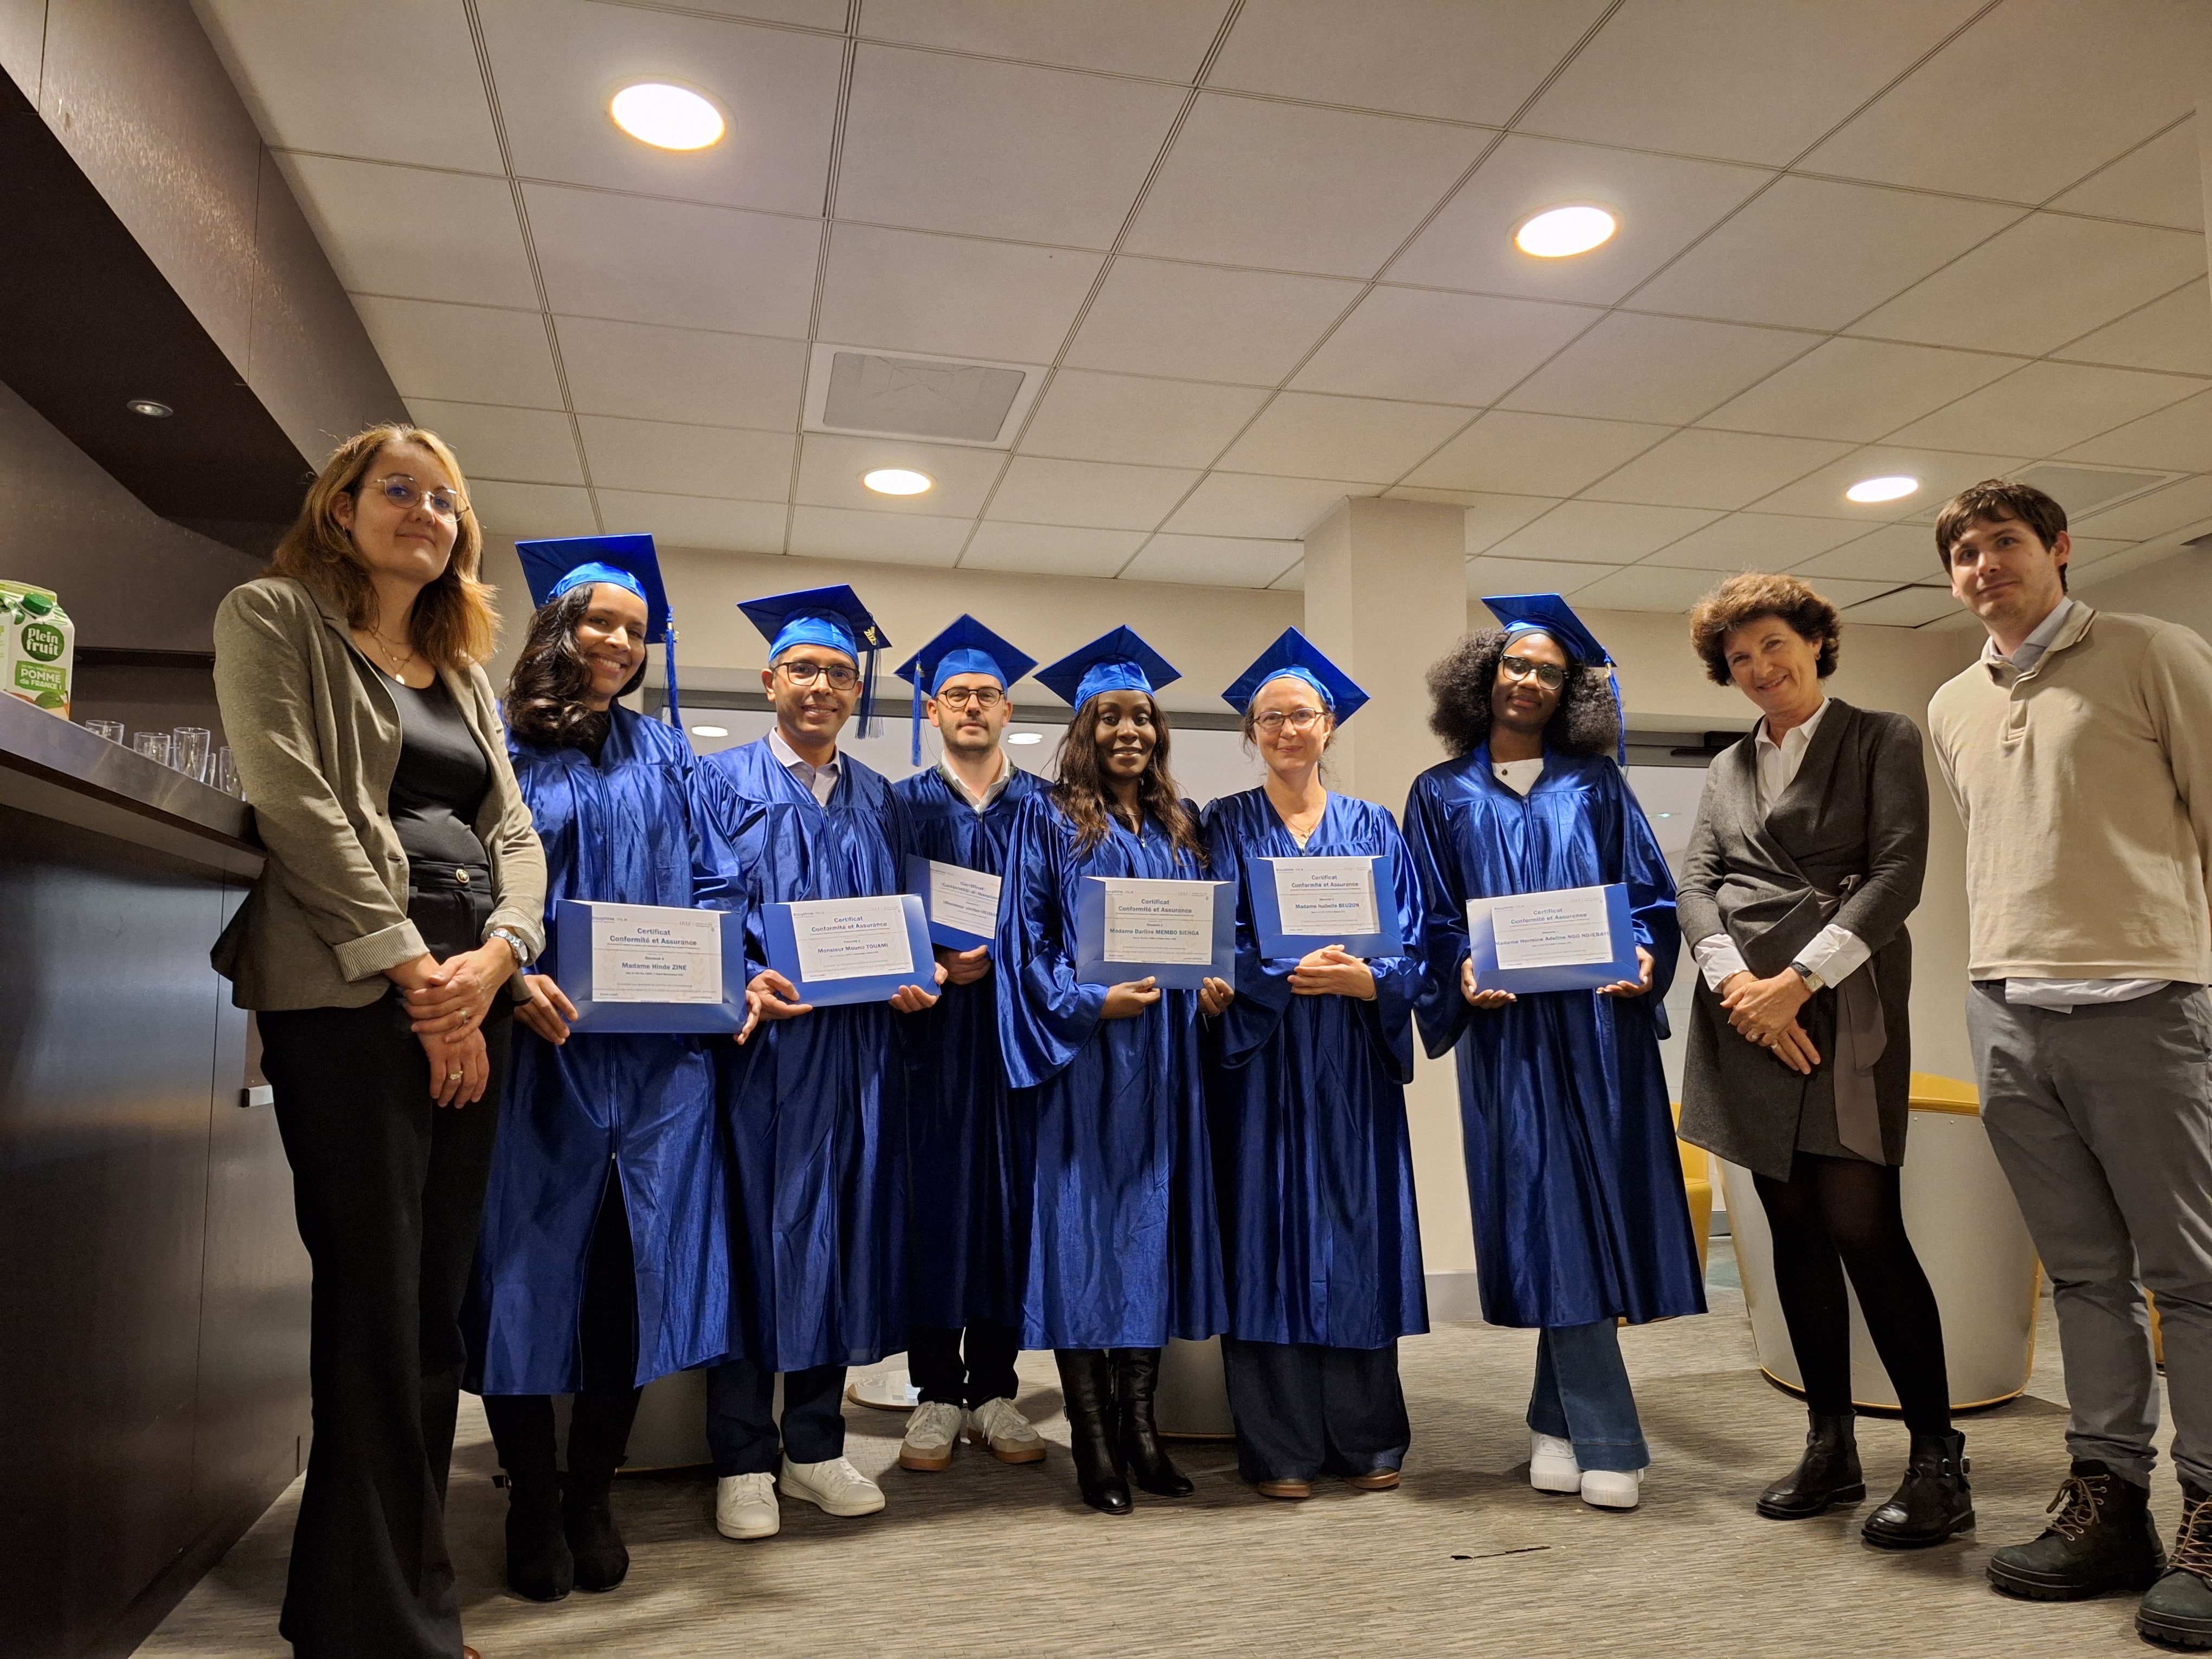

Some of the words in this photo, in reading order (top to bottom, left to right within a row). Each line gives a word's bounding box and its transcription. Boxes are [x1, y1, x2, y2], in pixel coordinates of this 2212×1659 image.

[28, 628, 59, 645] Plein
[27, 638, 59, 656] fruit
[21, 668, 61, 684] POMME
[31, 679, 58, 690] FRANCE
[637, 928, 671, 936] Certificat
[610, 935, 650, 943] Conformité
